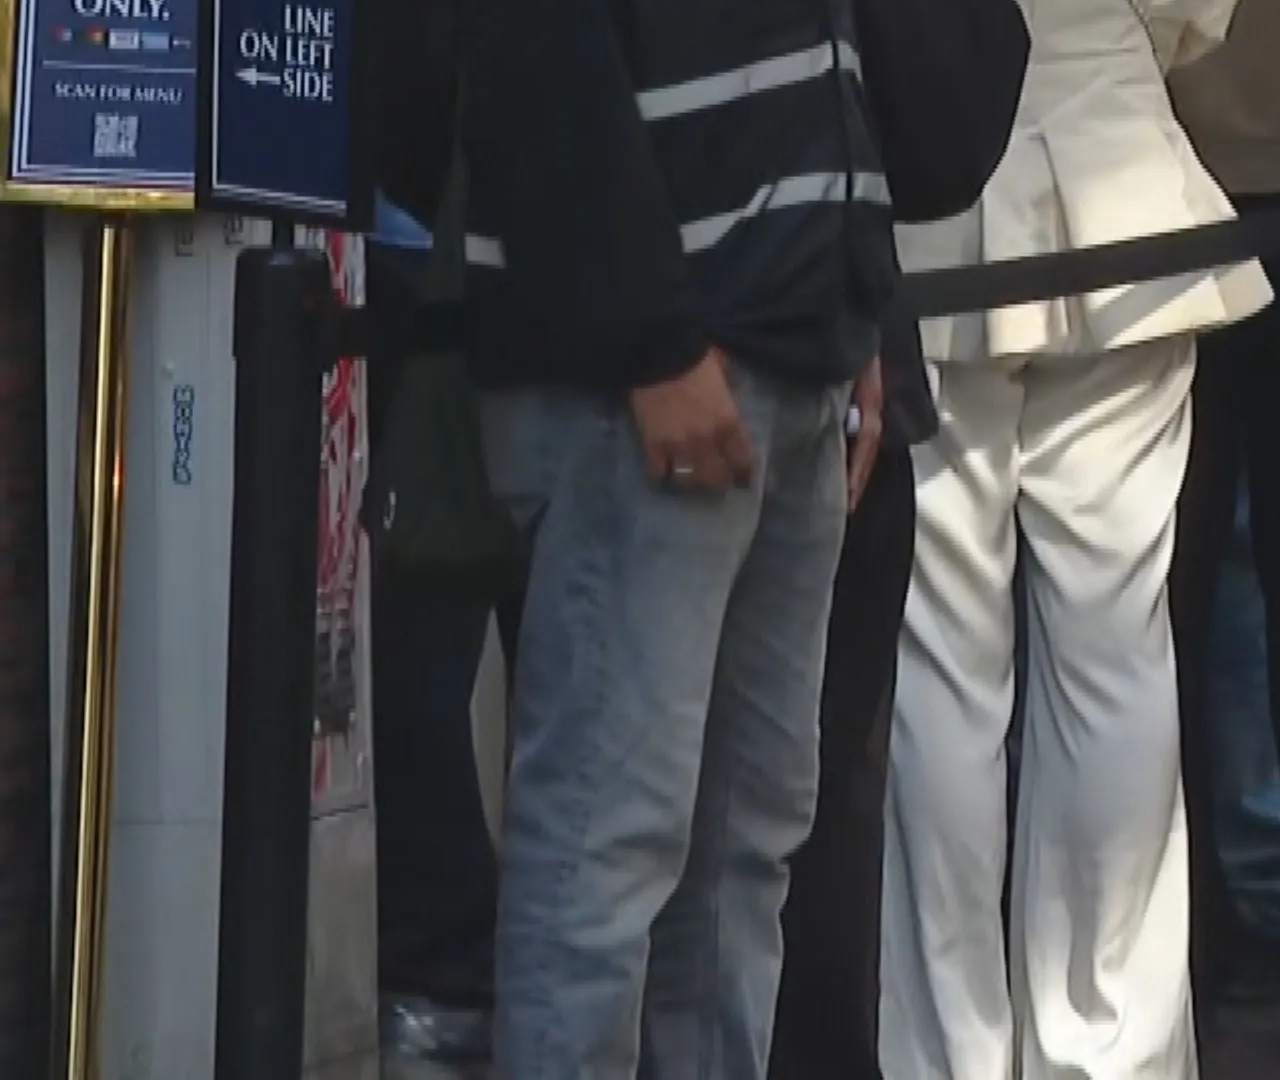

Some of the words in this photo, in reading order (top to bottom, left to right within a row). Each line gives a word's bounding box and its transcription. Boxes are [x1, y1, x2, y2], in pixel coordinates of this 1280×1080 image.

[284, 3, 334, 37] LINE
[240, 28, 279, 62] ON
[286, 35, 334, 70] LEFT
[54, 80, 96, 99] SCAN
[133, 87, 183, 105] MENU
[282, 67, 334, 102] SIDE
